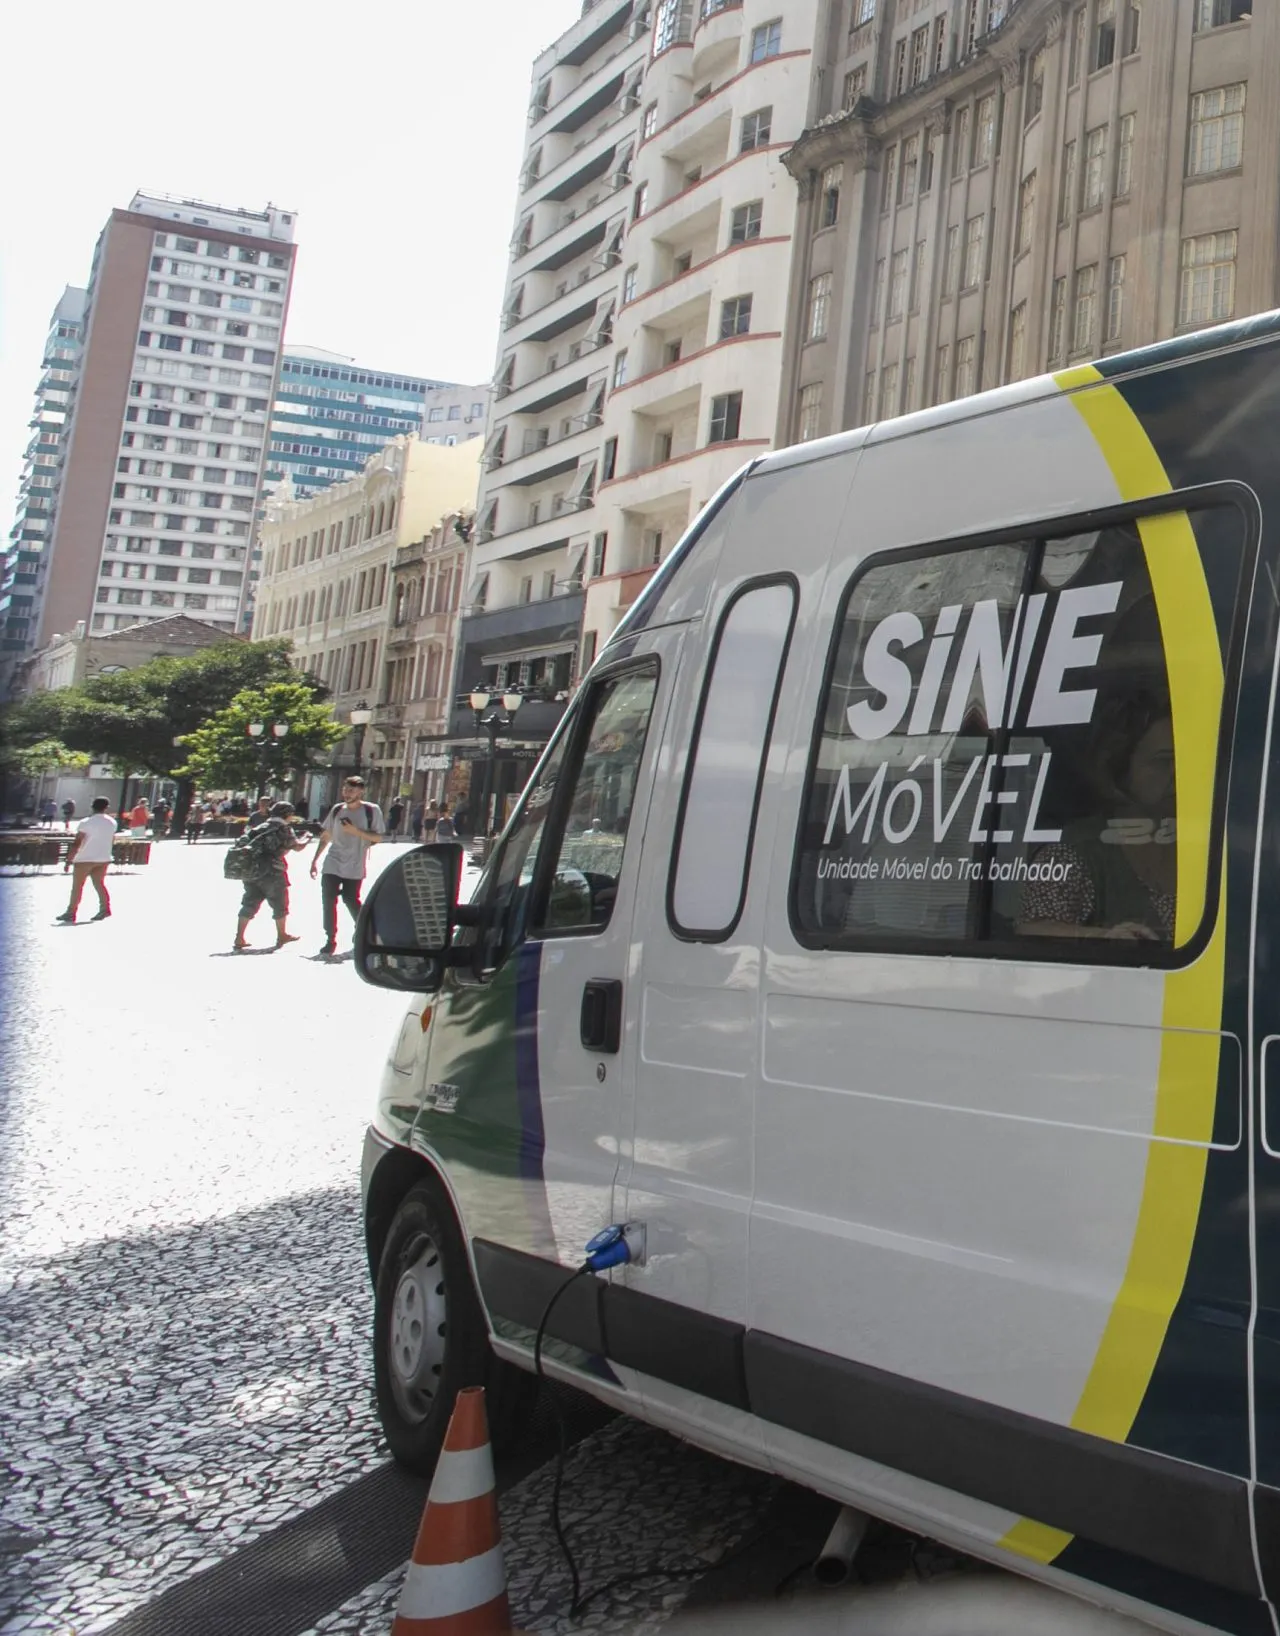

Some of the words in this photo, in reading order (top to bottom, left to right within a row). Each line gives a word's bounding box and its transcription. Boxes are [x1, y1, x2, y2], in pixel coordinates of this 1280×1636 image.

[816, 857, 879, 880] Unidade
[881, 856, 930, 880] Móvel
[930, 857, 952, 880] do
